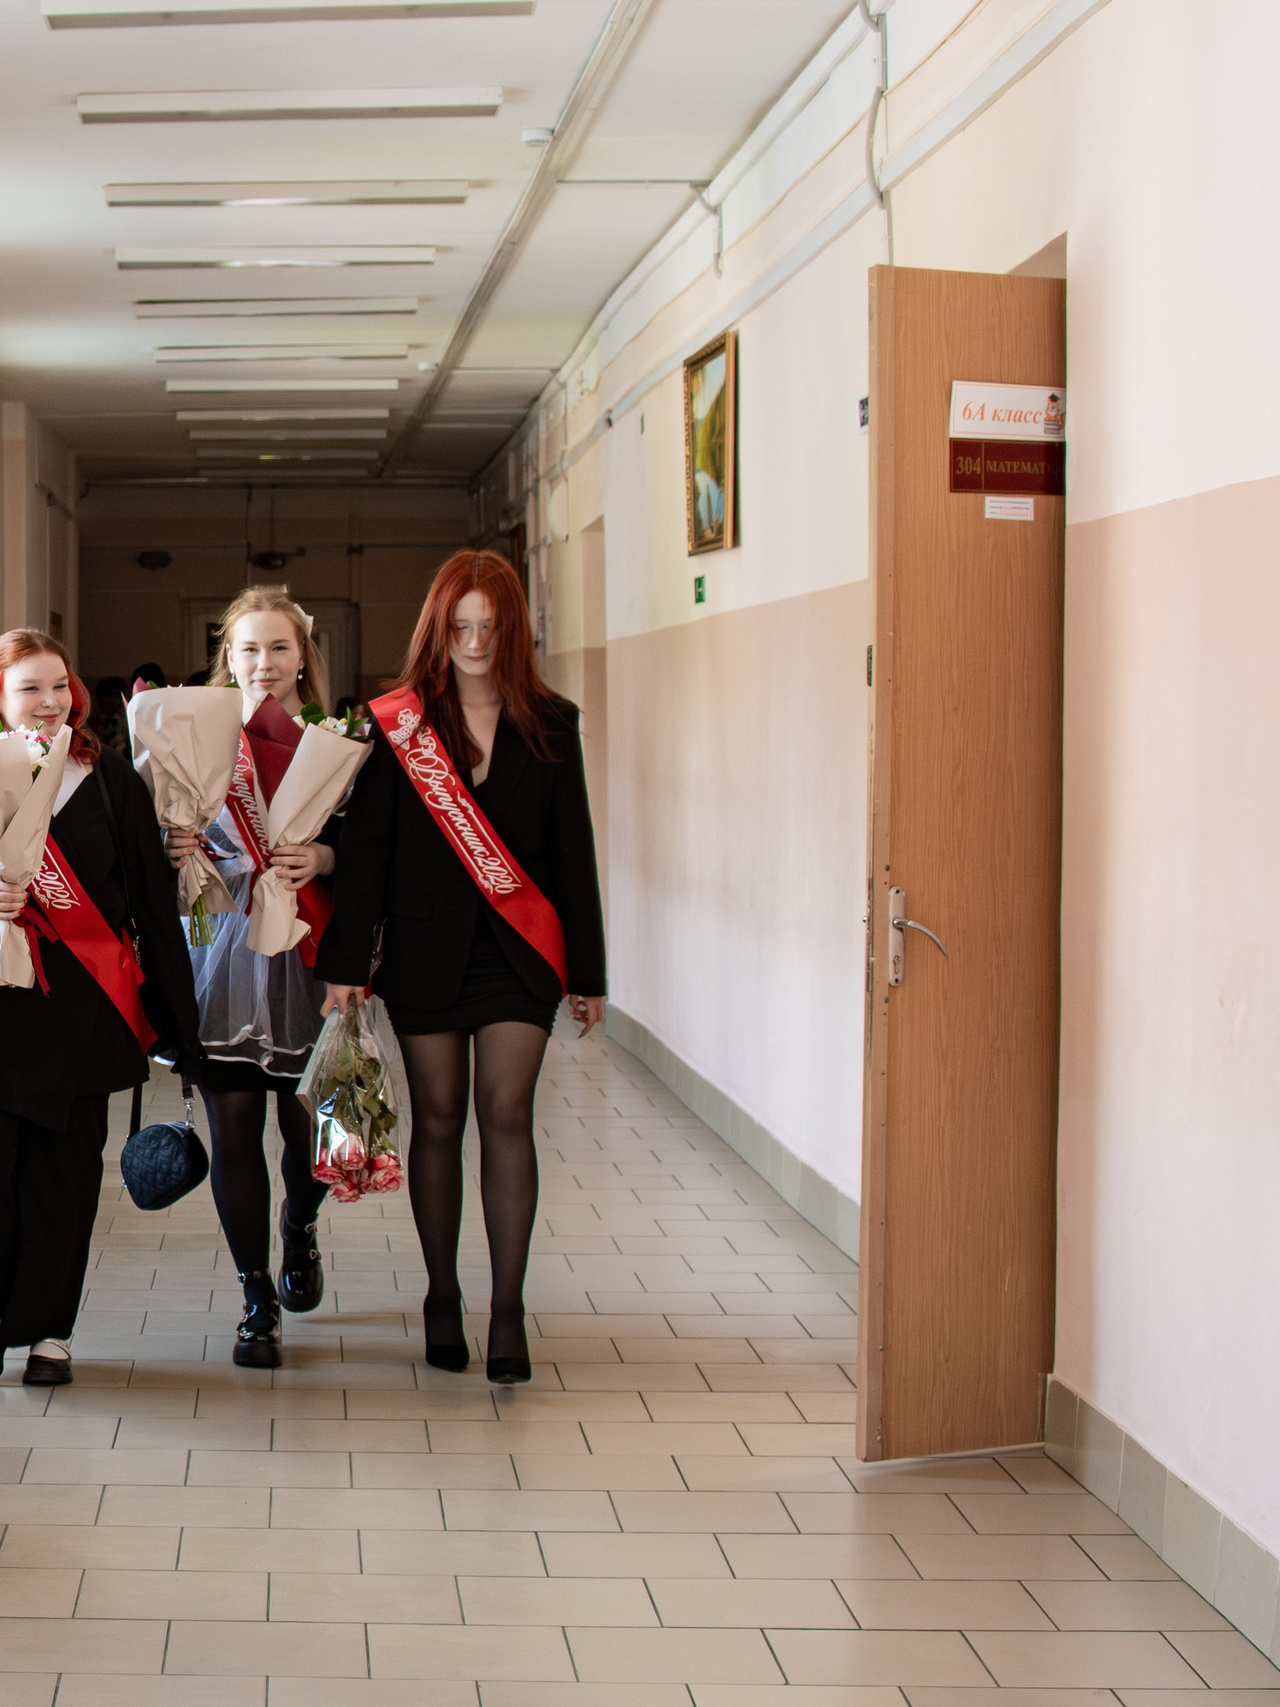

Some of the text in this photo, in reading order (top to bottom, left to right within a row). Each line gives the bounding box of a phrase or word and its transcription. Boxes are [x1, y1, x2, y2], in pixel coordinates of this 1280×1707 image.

[962, 400, 1042, 424] 6А класс
[956, 456, 981, 475] 304
[405, 748, 523, 895] Выпускник 2026
[35, 871, 81, 910] 2026
